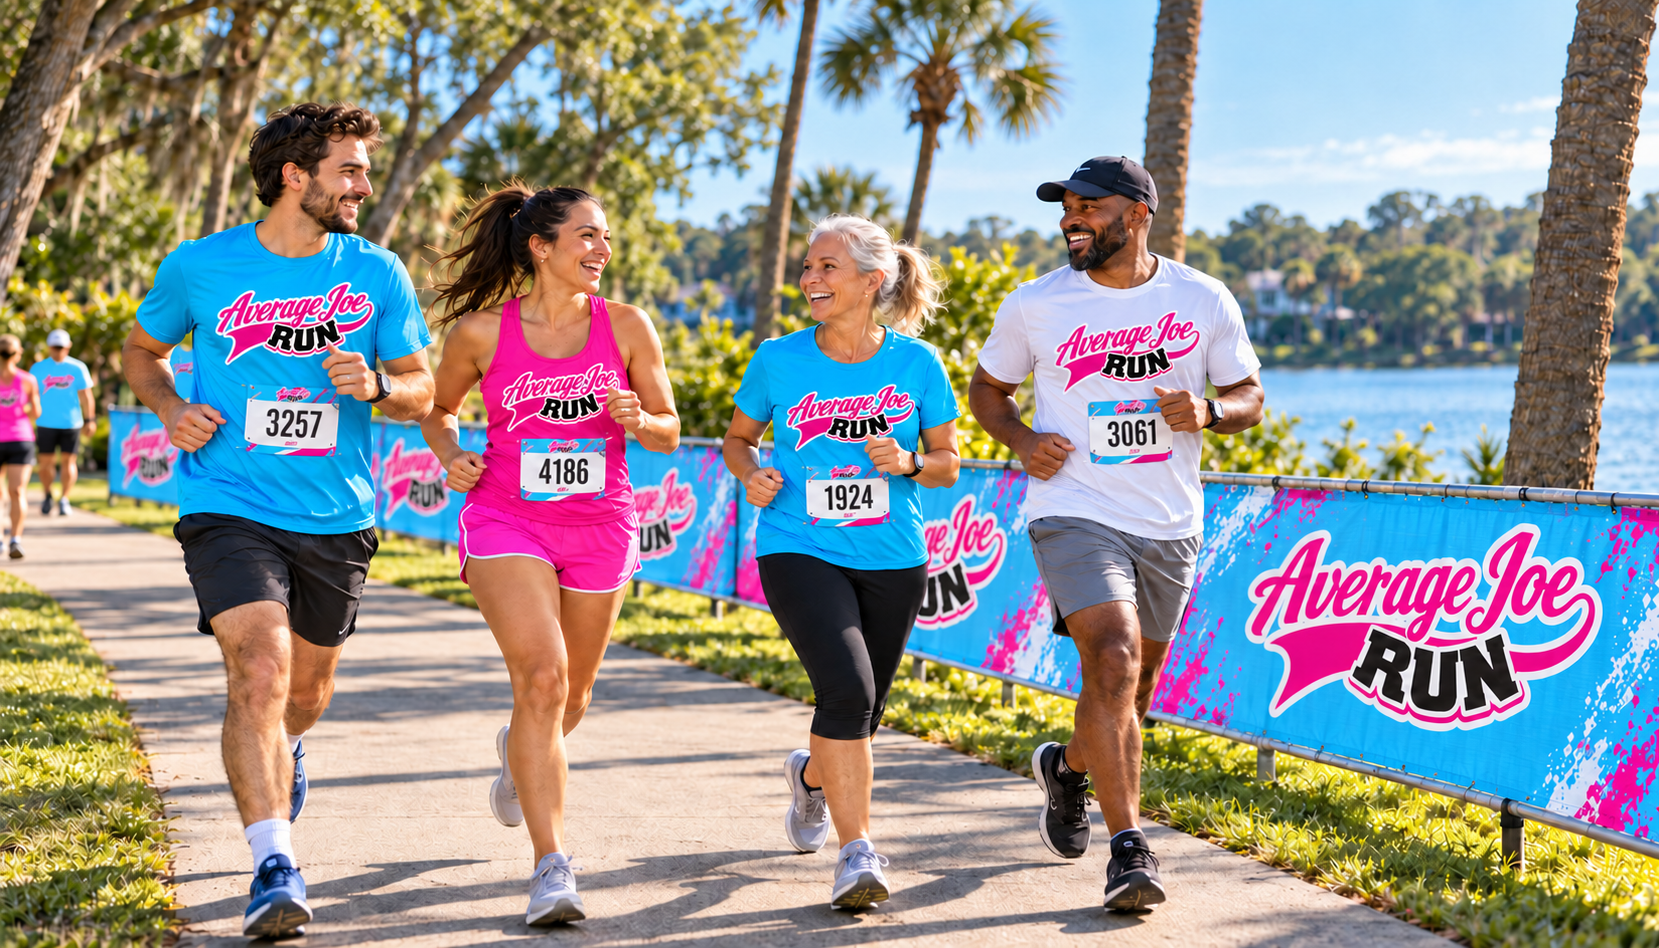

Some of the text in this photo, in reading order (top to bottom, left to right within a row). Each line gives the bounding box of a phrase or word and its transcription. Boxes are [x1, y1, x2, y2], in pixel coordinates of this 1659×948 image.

[216, 283, 367, 333] Average Joe
[267, 319, 340, 352] RUN
[1056, 312, 1194, 366] Average Joe
[1102, 348, 1171, 379] RUN
[503, 364, 615, 407] Average Joe
[265, 408, 323, 438] 3257
[540, 393, 600, 420] RUN
[787, 385, 909, 426] Average Joe
[827, 413, 890, 439] RUN
[1107, 418, 1157, 448] 3061
[538, 458, 589, 485] 4186
[824, 484, 874, 511] 1924
[640, 518, 672, 553] UN
[944, 500, 995, 564] Joe
[918, 562, 971, 618] UN
[1251, 531, 1579, 642] Average Joe
[1352, 629, 1519, 712] RUN
